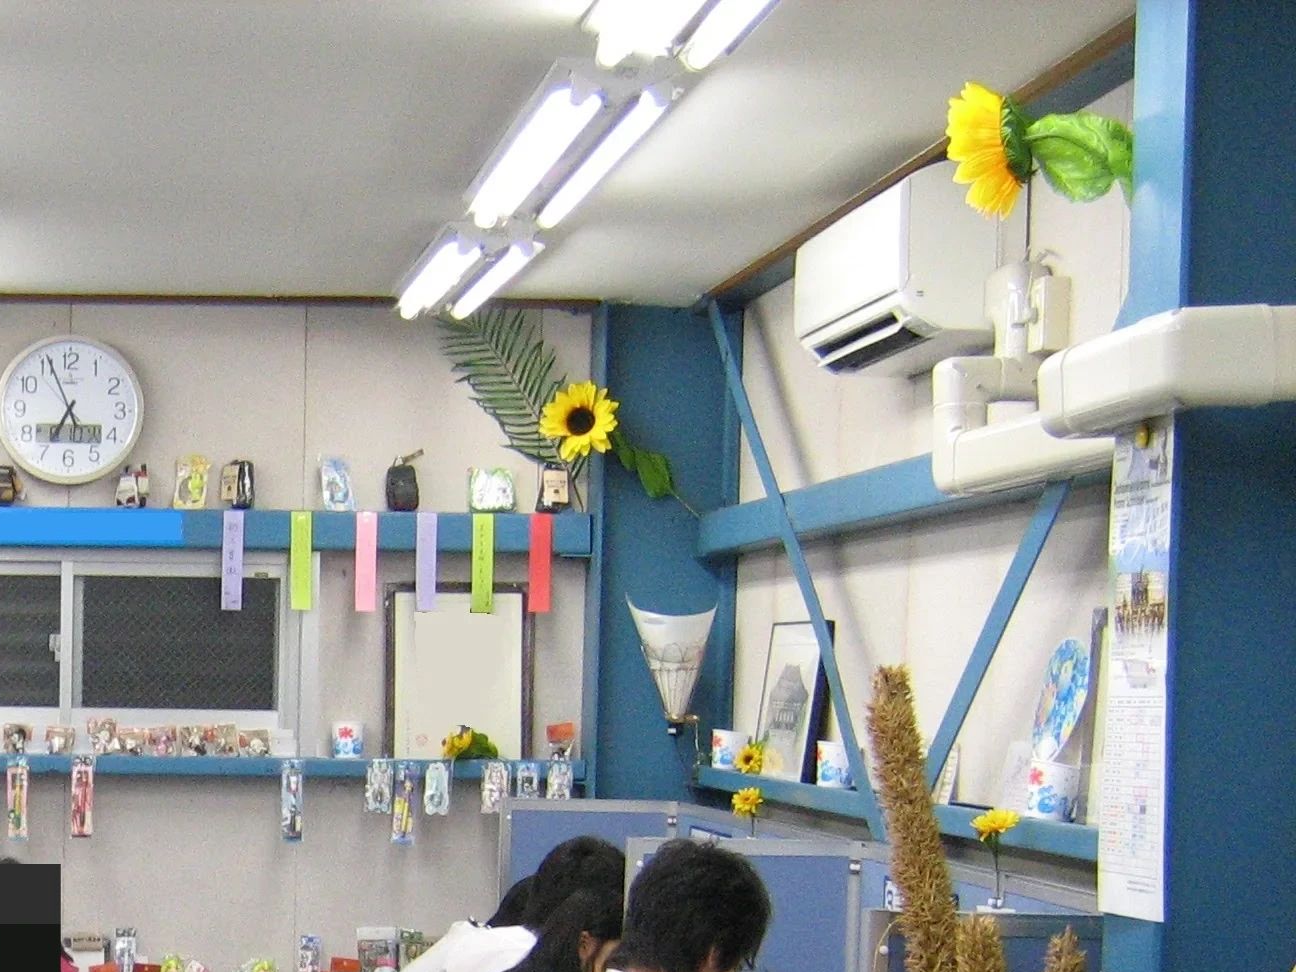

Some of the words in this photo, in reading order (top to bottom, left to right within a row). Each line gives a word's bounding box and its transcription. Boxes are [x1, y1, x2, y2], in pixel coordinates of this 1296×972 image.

[62, 352, 80, 370] 12
[20, 375, 38, 394] 10
[107, 377, 121, 396] 2
[13, 399, 26, 418] 9
[114, 402, 126, 420] 3
[20, 424, 33, 443] 8
[106, 427, 118, 444] 4
[39, 444, 50, 461] 7
[62, 449, 75, 468] 6
[88, 445, 100, 463] 5
